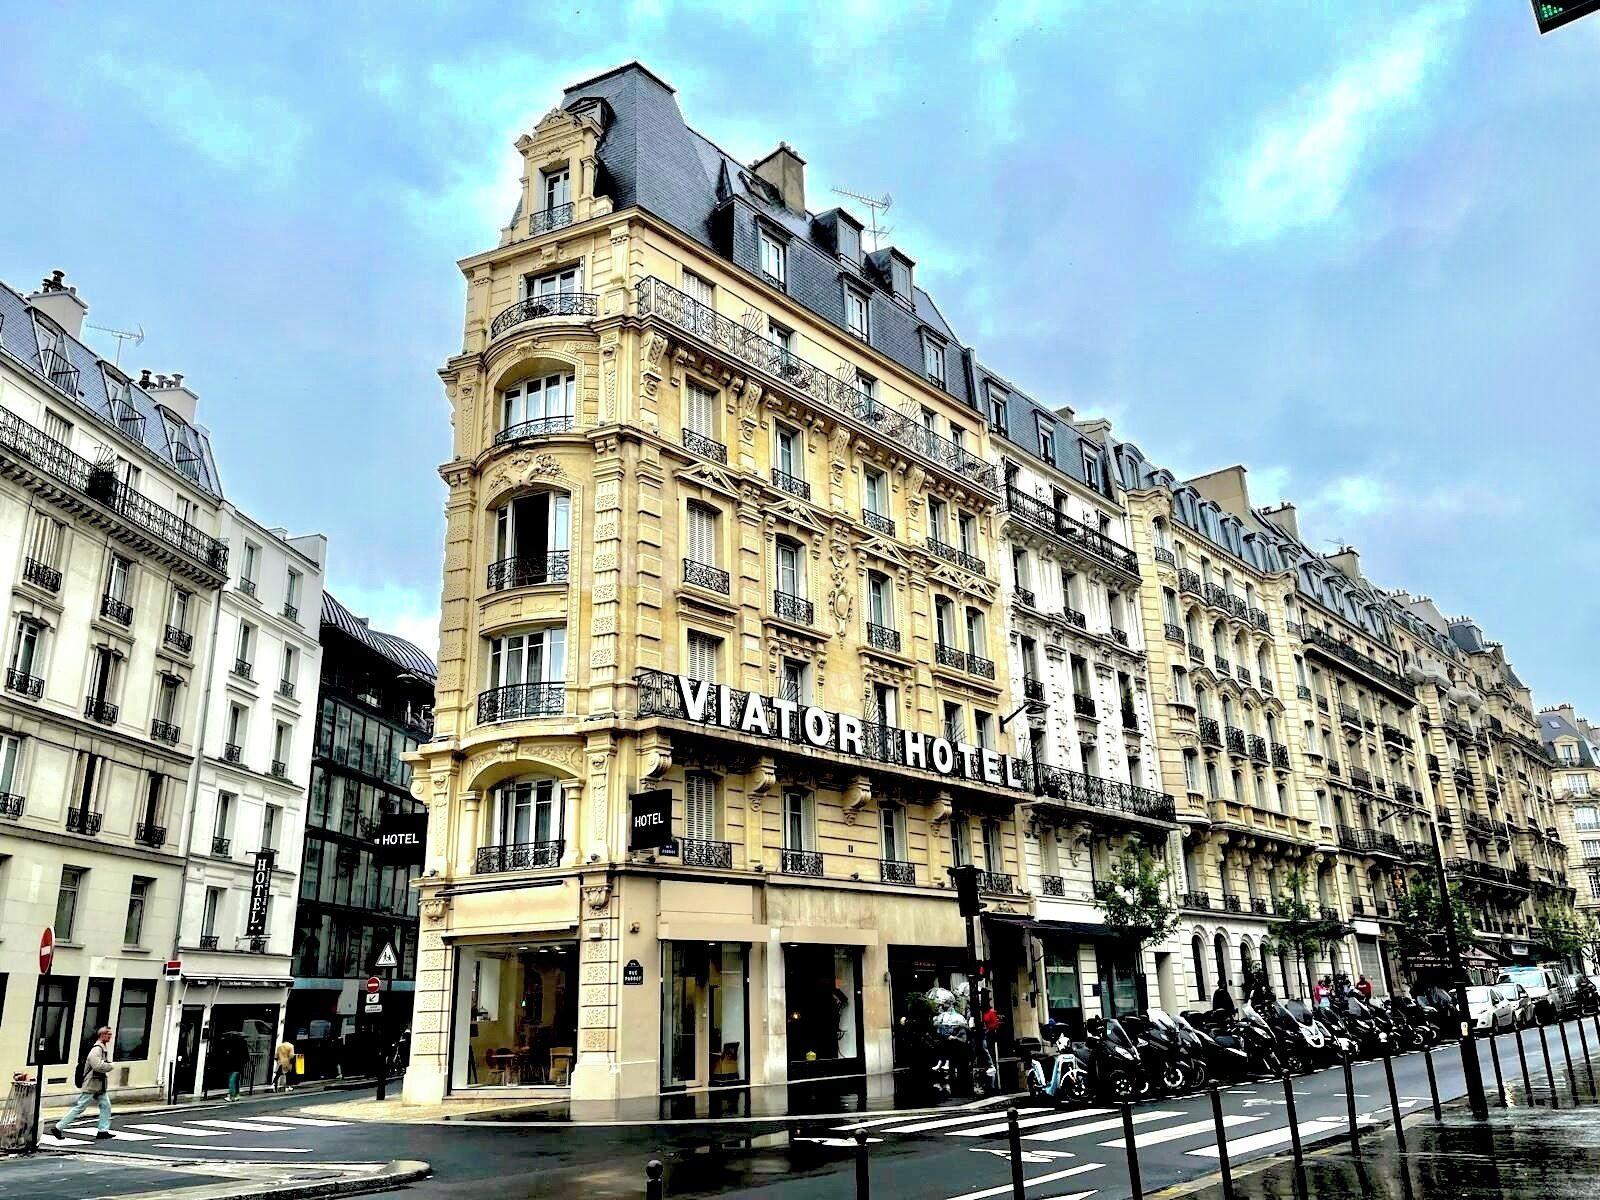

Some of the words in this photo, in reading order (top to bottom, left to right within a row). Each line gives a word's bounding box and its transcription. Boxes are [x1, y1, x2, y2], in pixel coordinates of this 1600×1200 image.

[679, 675, 864, 756] VIATOR
[904, 729, 1022, 791] HOTEL
[382, 833, 420, 845] HOTEL
[634, 812, 664, 828] HOTEL
[250, 858, 267, 924] HOTEL
